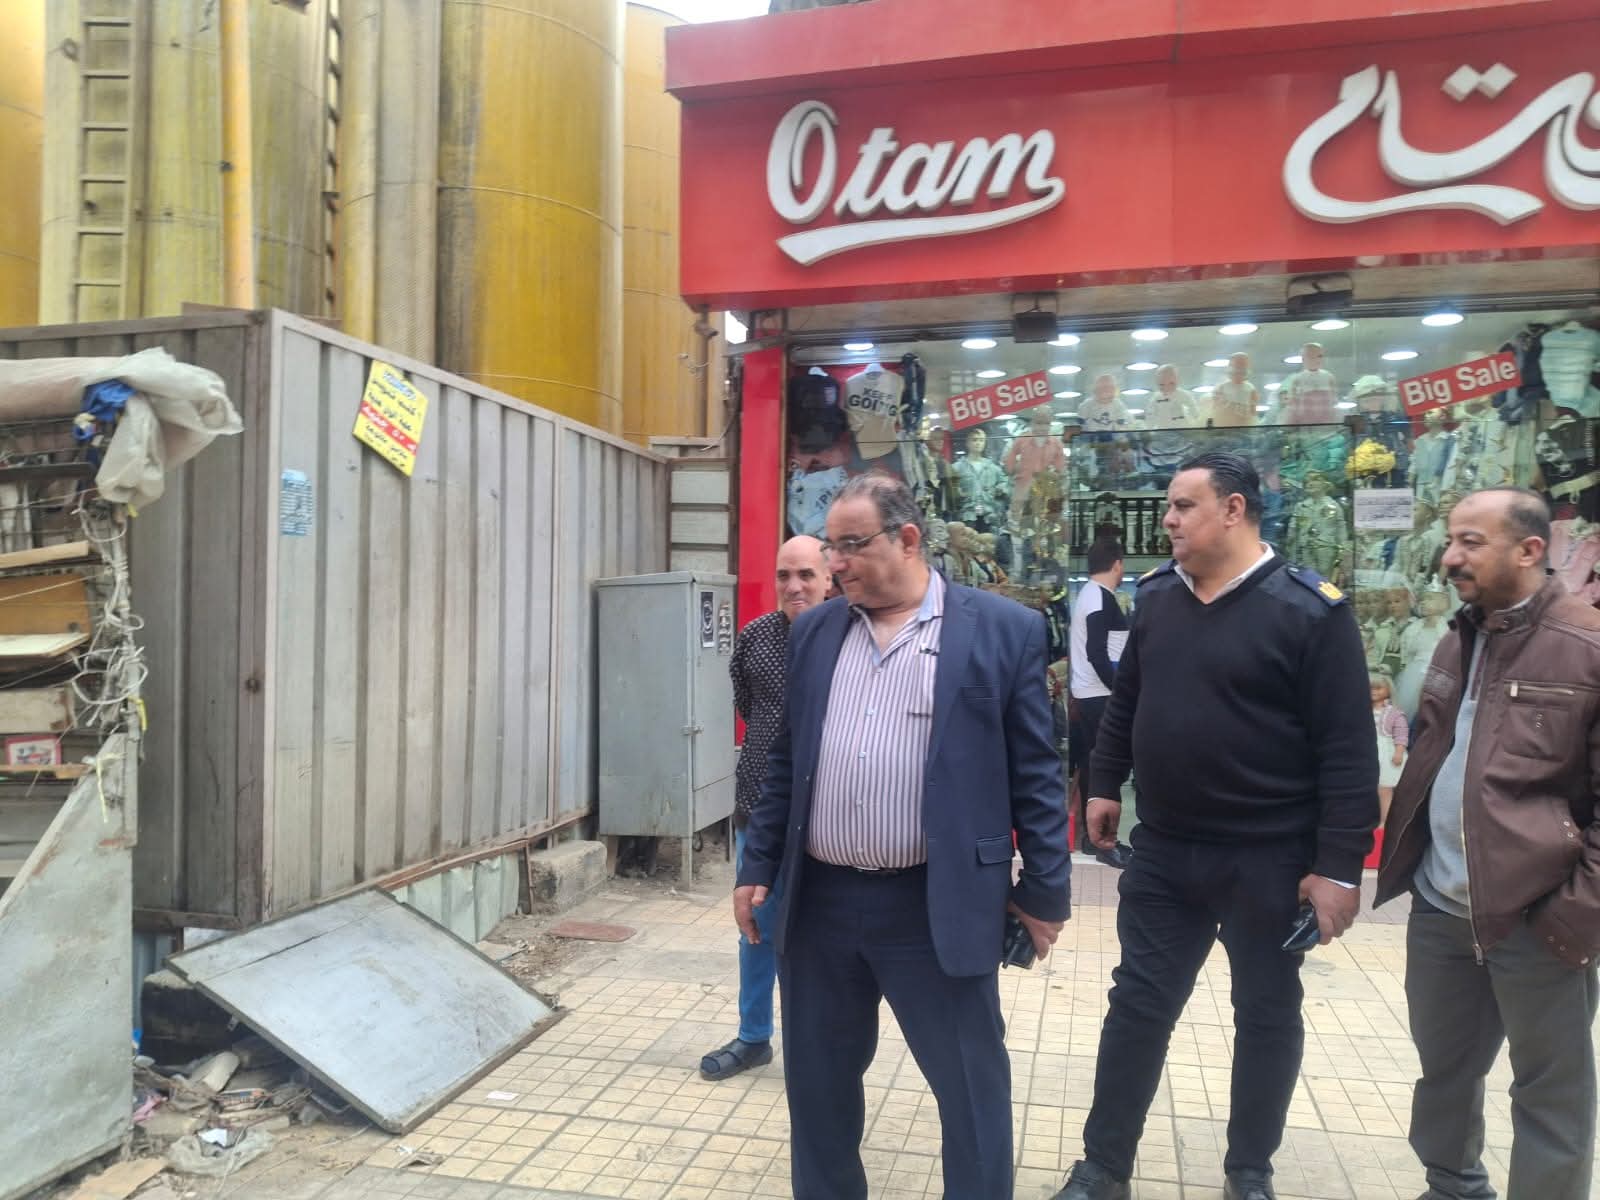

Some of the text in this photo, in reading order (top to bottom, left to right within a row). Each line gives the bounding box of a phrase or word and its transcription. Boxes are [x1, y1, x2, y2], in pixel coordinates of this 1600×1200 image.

[767, 99, 1066, 265] Otam
[951, 377, 1048, 420] Big Sale
[1403, 359, 1515, 406] Big Sale
